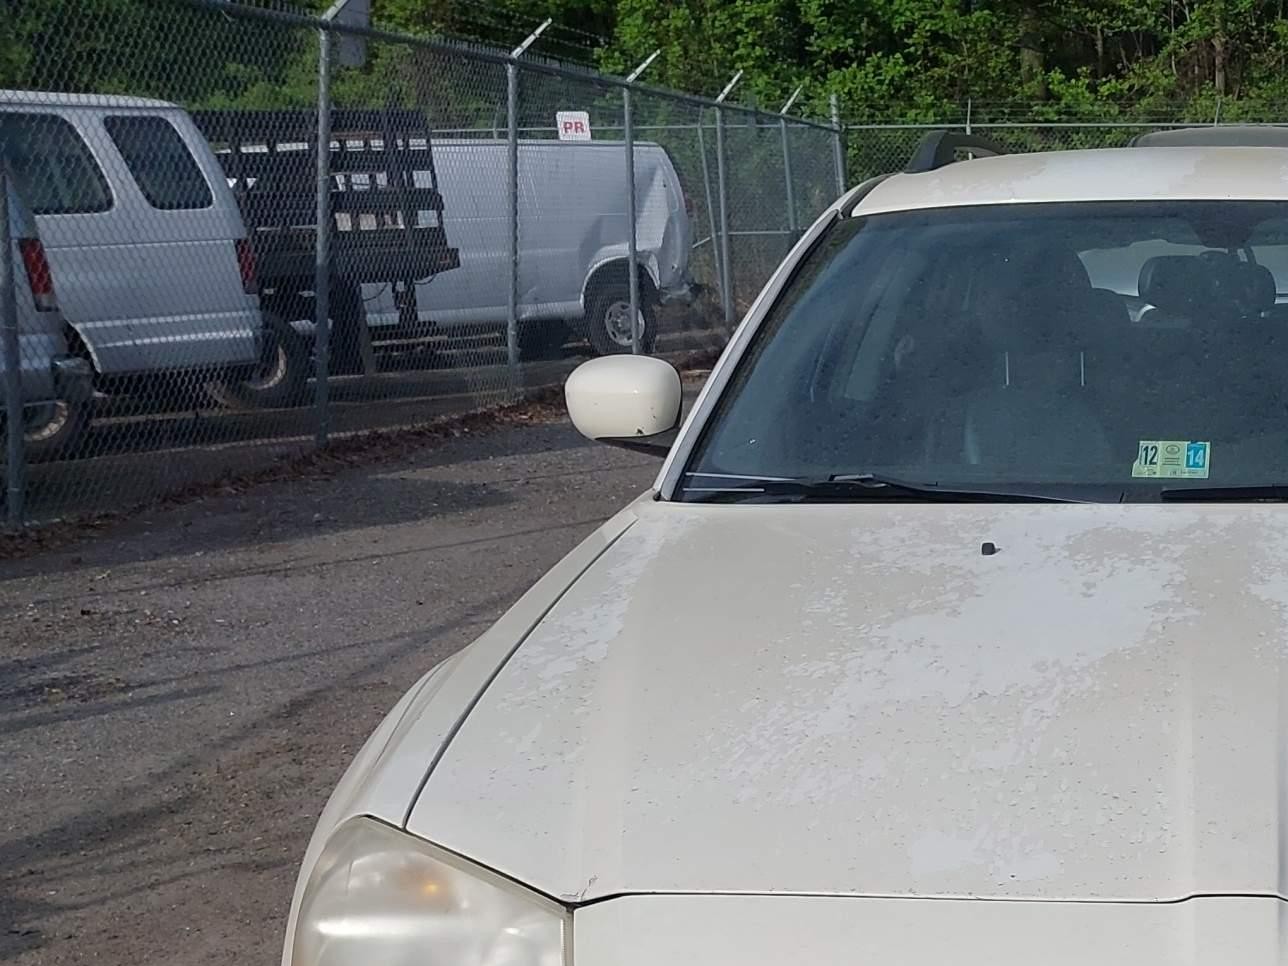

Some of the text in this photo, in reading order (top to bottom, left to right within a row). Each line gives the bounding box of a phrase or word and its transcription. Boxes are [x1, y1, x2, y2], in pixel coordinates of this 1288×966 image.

[563, 121, 585, 134] PR
[1143, 445, 1158, 466] 12
[1187, 449, 1205, 467] 14
